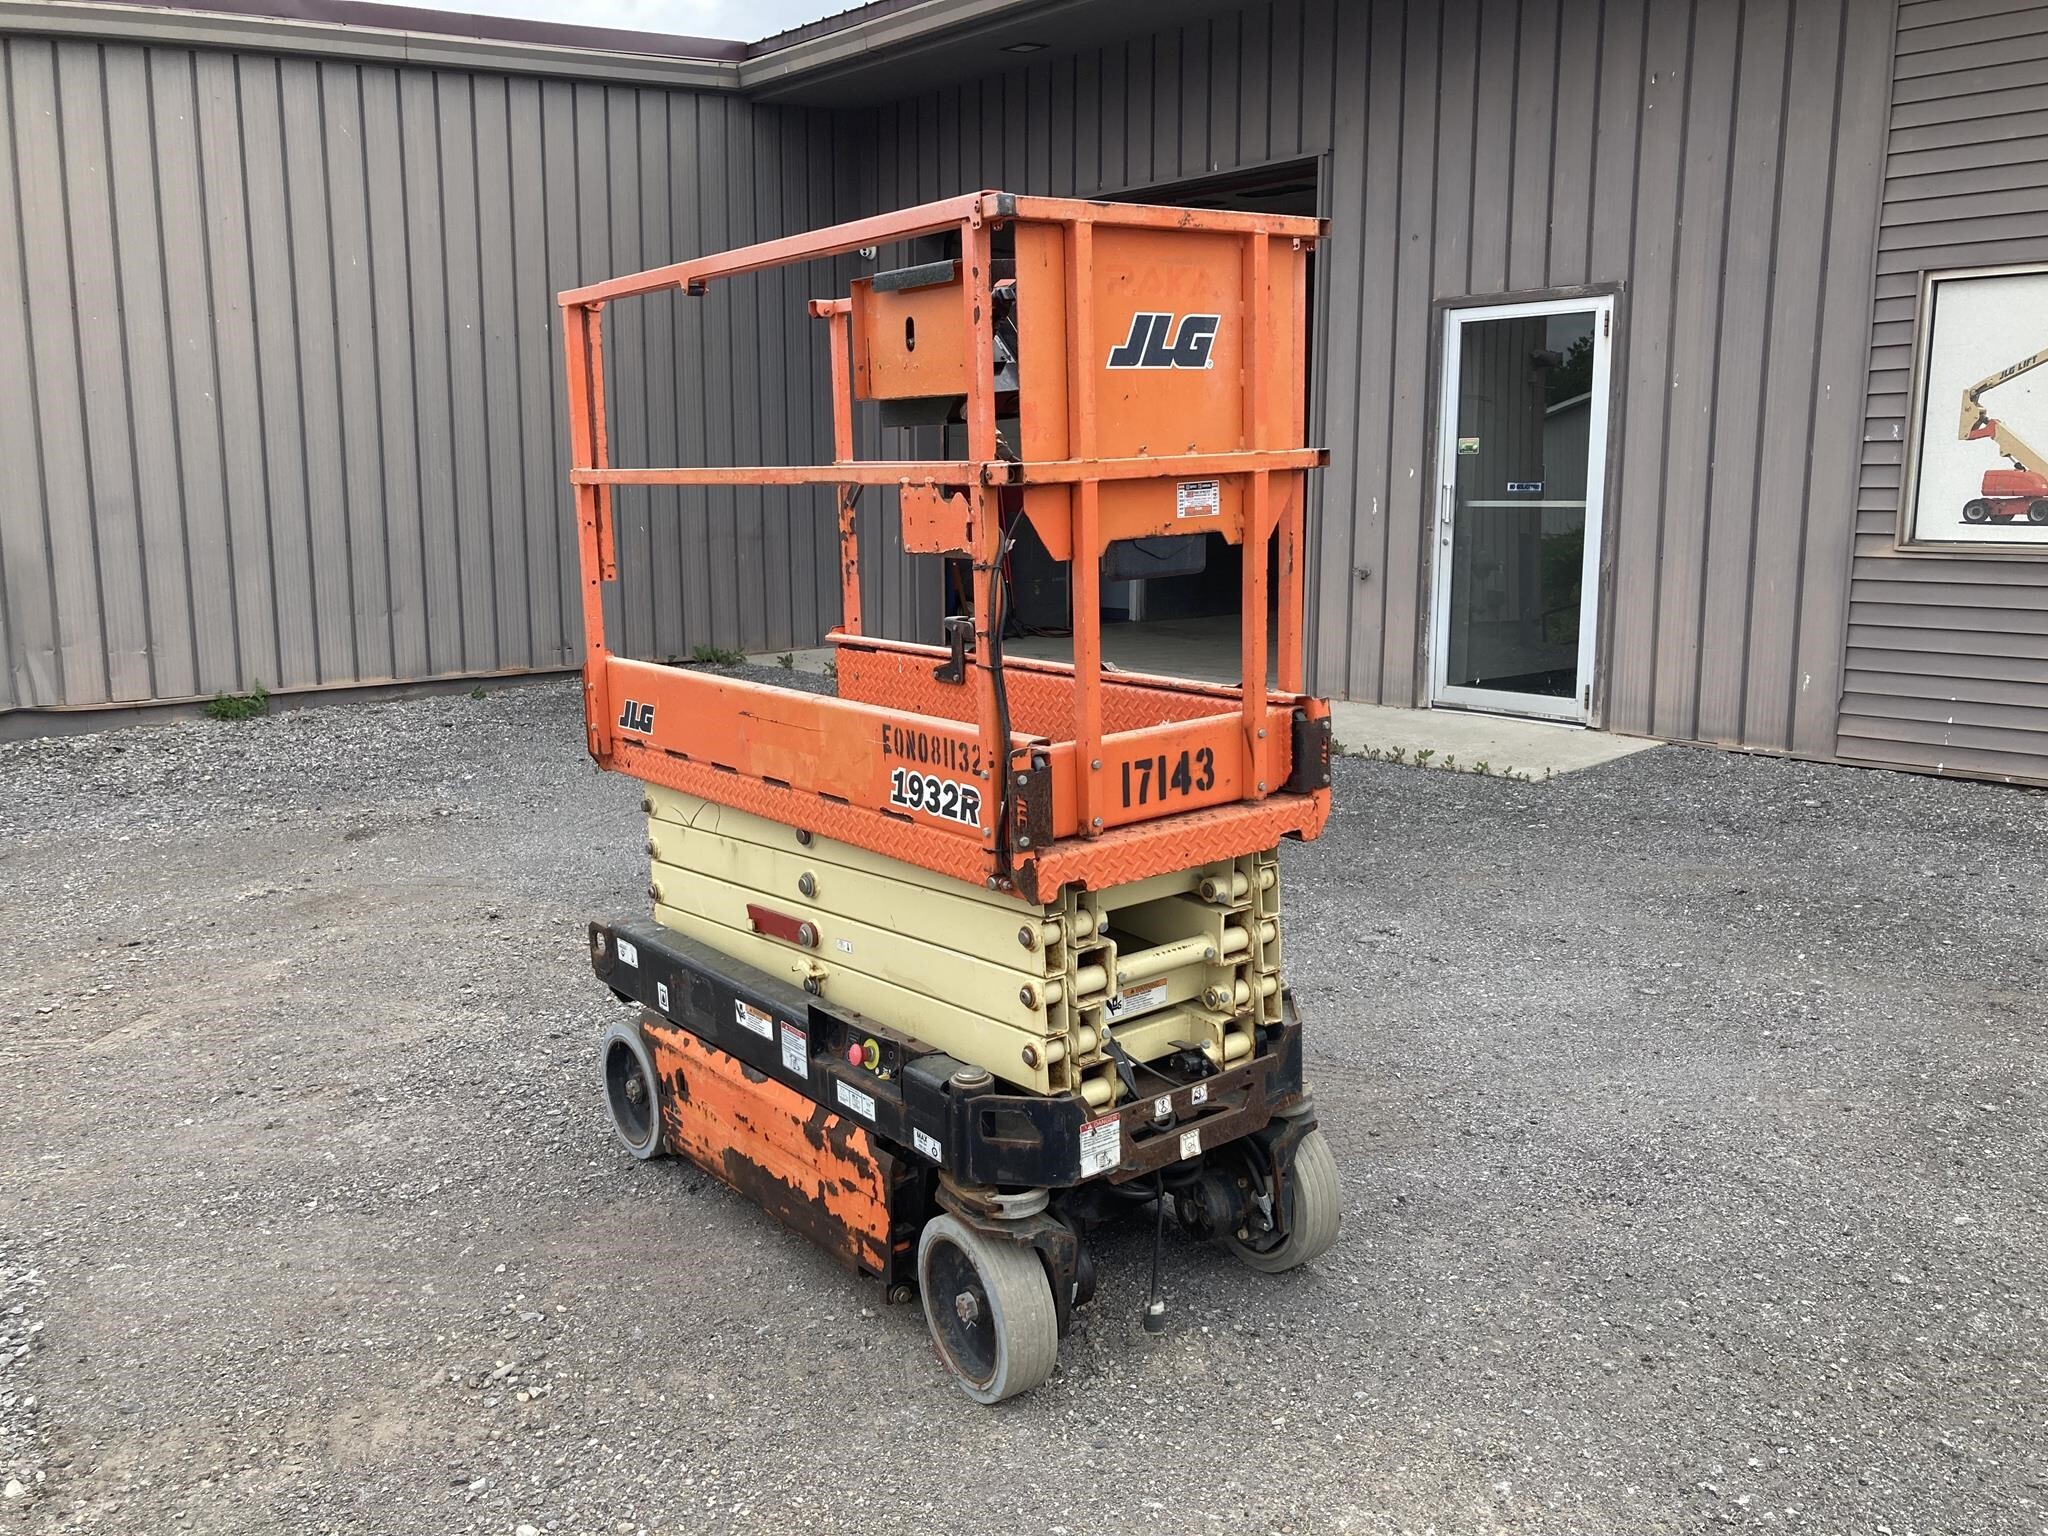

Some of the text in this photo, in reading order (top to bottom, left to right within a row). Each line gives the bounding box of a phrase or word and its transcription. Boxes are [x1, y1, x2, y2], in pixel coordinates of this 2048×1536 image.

[1107, 312, 1220, 369] JLG
[2000, 355, 2037, 380] JLG LIFT
[618, 699, 655, 735] JLG
[892, 768, 981, 827] 1932R
[1122, 747, 1215, 808] 17143
